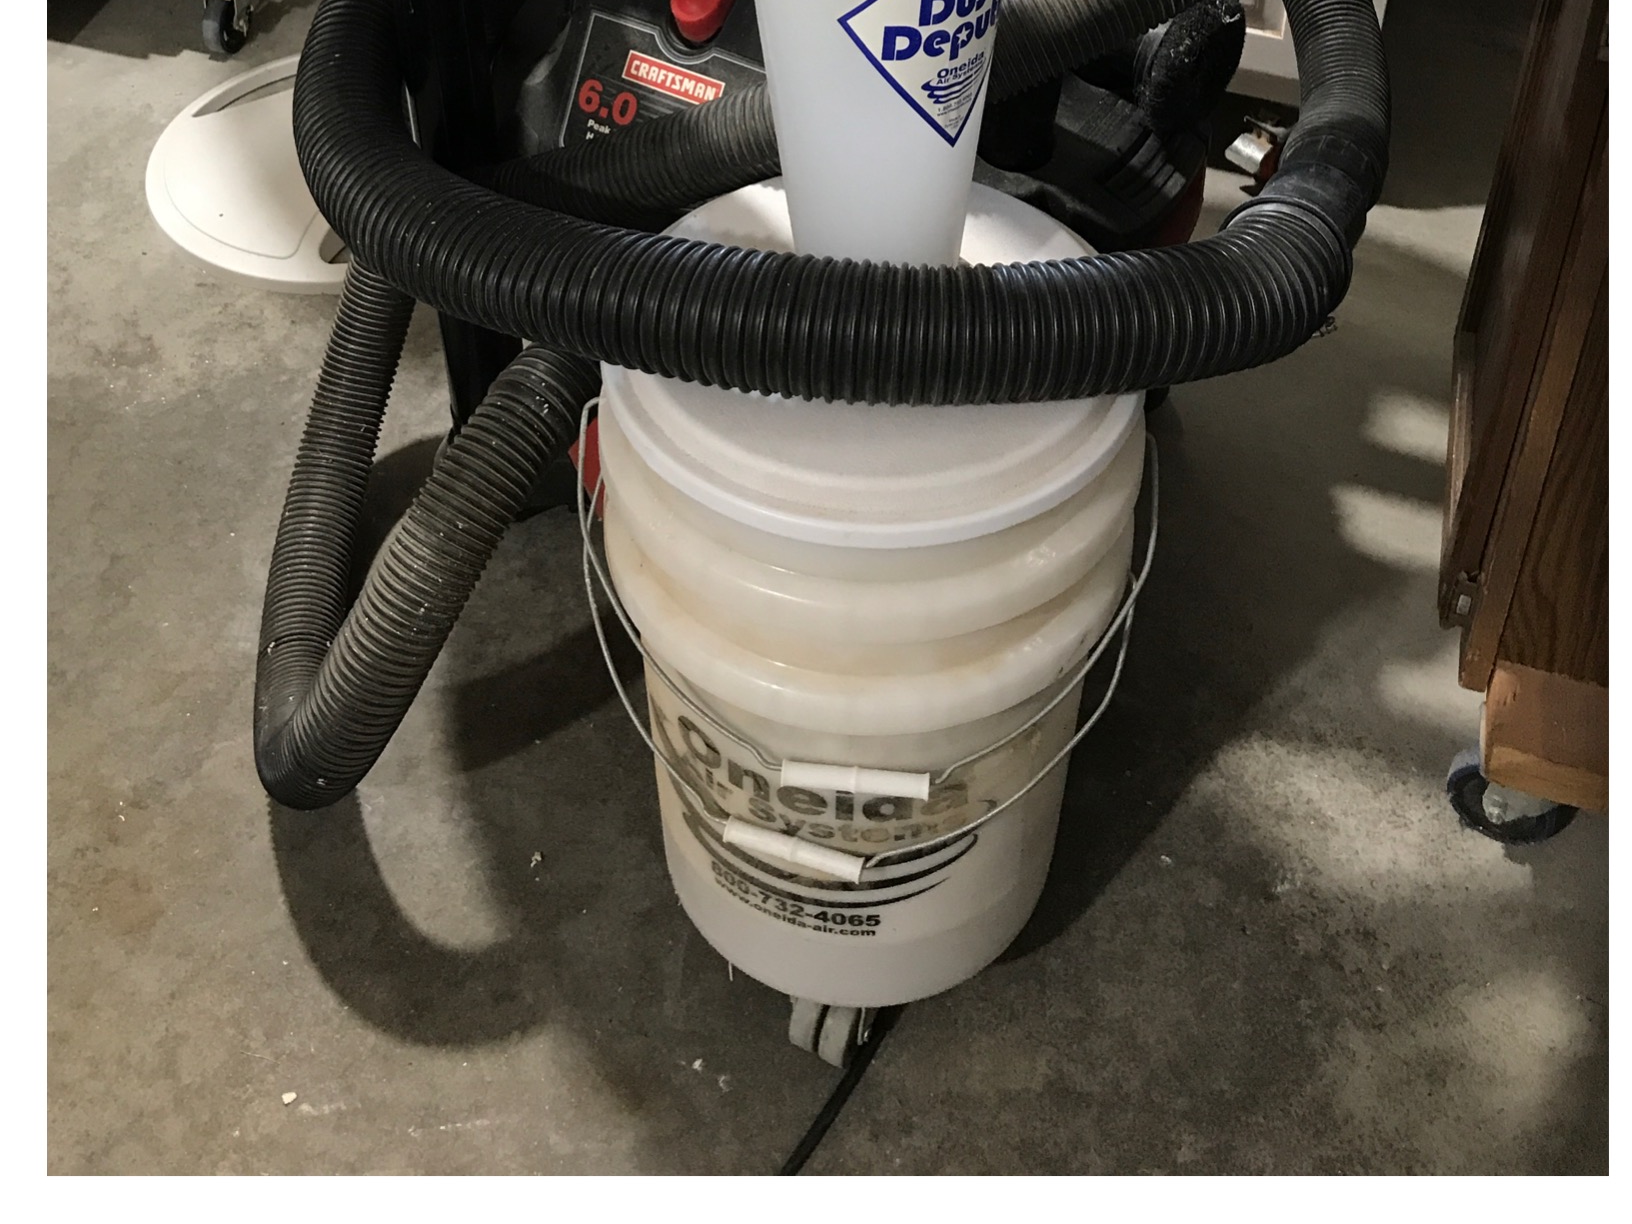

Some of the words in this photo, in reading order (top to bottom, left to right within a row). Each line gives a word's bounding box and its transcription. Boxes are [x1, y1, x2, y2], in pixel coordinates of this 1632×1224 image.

[630, 59, 717, 101] CRAFTSMAN
[936, 51, 985, 79] Oneida
[936, 76, 951, 85] Air
[578, 78, 638, 126] 6.0
[587, 118, 612, 135] Peak
[678, 715, 968, 822] Oneida
[710, 860, 881, 928] 800-732-4065
[714, 877, 876, 938] www.oneida-air.com
